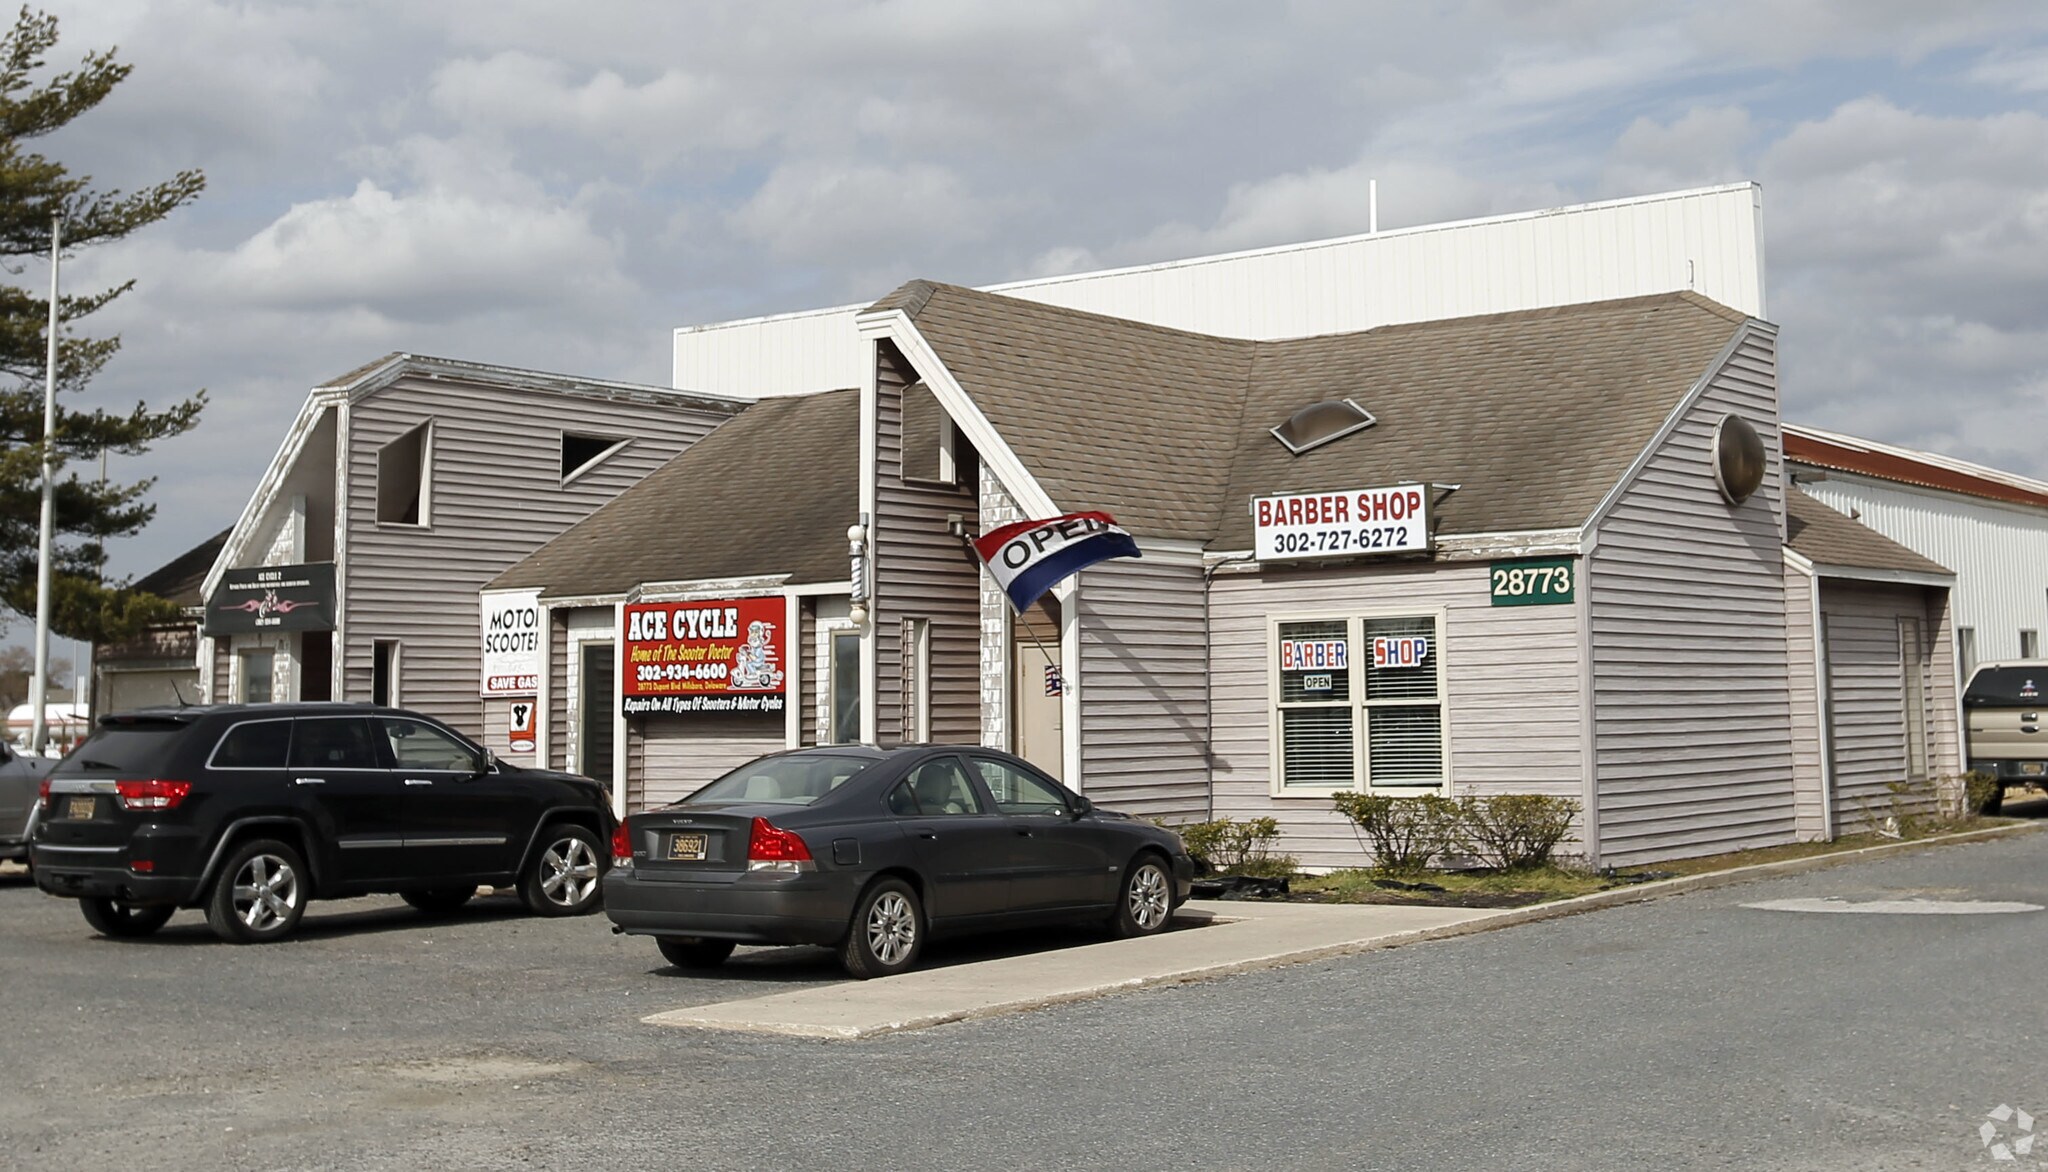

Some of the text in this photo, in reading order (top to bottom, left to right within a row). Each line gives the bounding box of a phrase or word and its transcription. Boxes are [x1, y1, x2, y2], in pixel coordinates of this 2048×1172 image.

[1258, 491, 1421, 527] BARBER SHOP
[1493, 566, 1571, 596] 28773
[628, 607, 738, 641] ACE CYCLE
[630, 642, 734, 662] Home of The Scooter Doctor
[1282, 638, 1427, 668] BARBER SHOP
[636, 663, 727, 681] 302-934-6600
[490, 675, 538, 690] SAVE GAS
[1306, 677, 1330, 688] OPEN
[624, 695, 783, 714] Repairs On All Types Of Scooters & Motor Cycles
